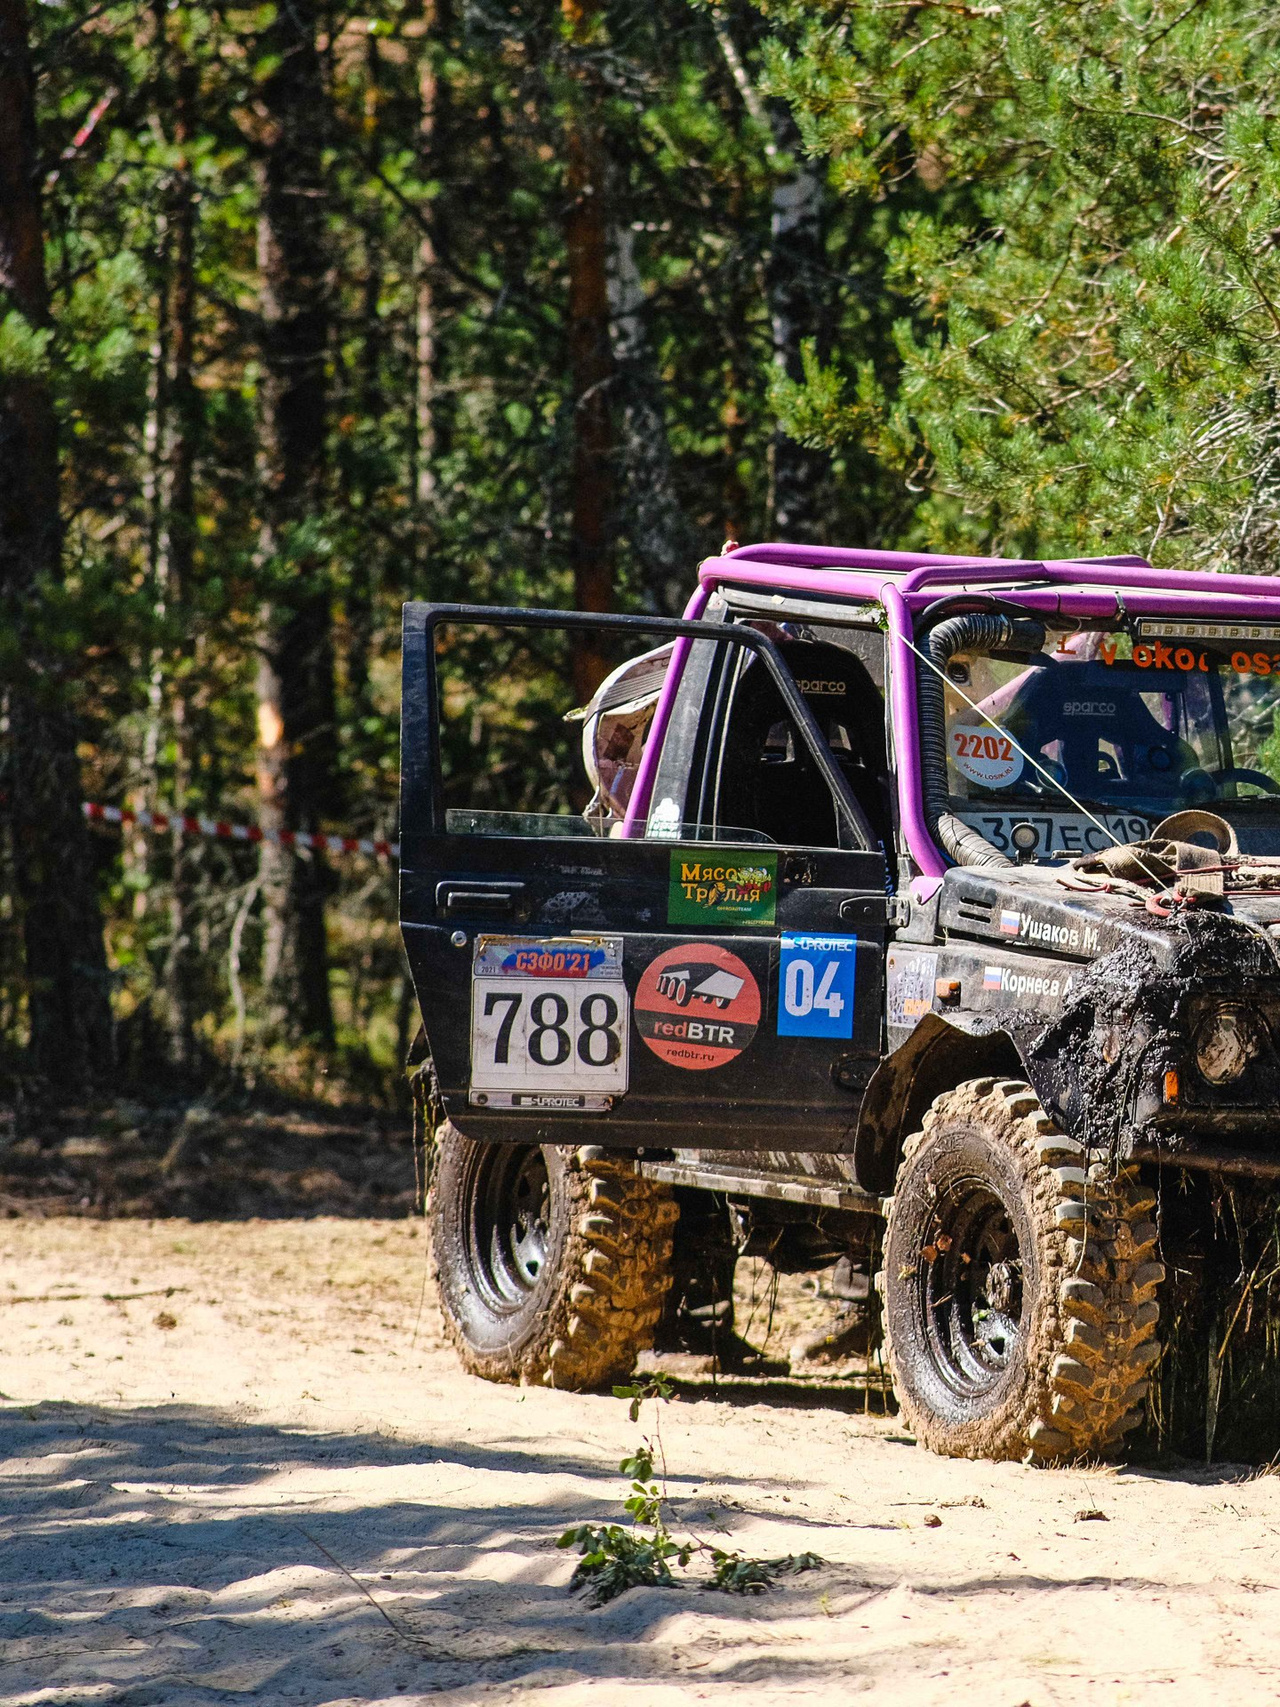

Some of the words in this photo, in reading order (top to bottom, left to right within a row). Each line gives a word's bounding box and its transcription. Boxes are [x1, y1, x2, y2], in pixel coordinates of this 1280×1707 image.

[1063, 702, 1116, 716] sparco
[954, 733, 1014, 761] 2202
[1020, 913, 1079, 946] Ушаков
[1083, 927, 1101, 951] М.
[784, 959, 845, 1018] 04
[1000, 968, 1060, 997] Корнеев
[483, 992, 621, 1067] 788
[653, 1021, 735, 1044] redBTR
[666, 1048, 715, 1061] redbtr.ru
[531, 1097, 579, 1107] SUPROTEC
